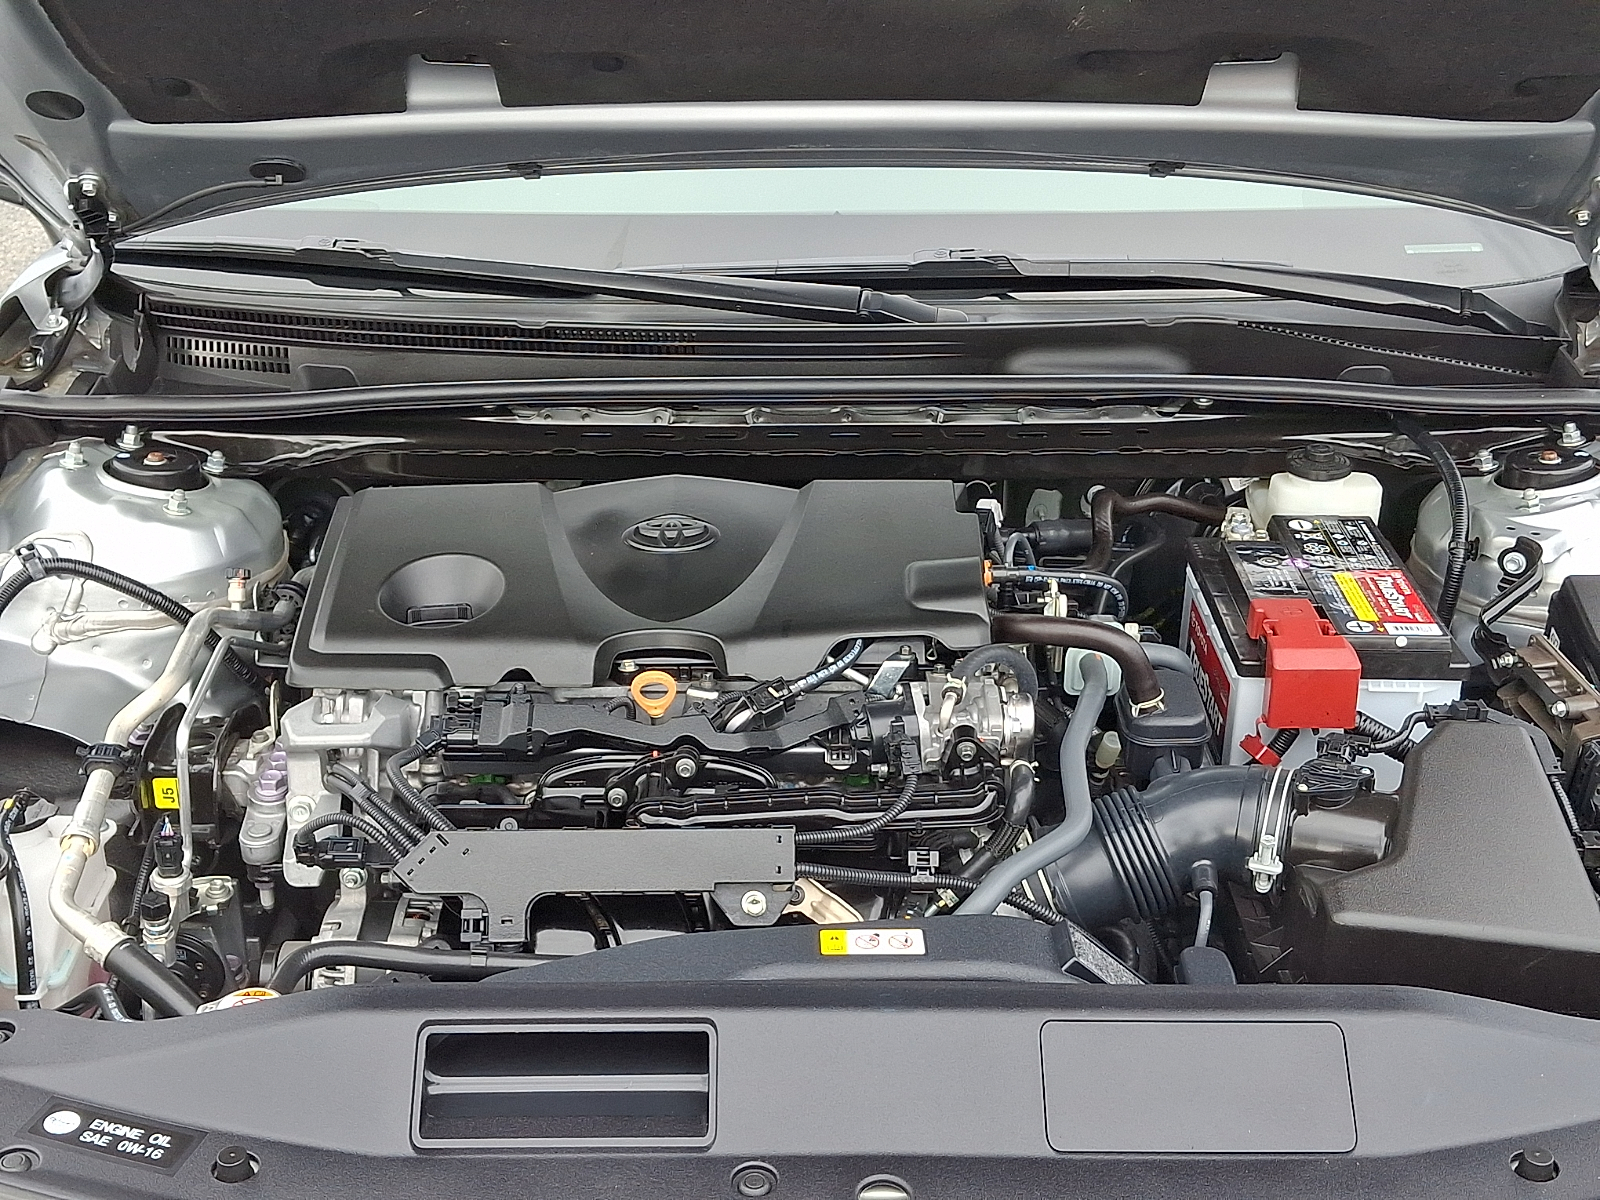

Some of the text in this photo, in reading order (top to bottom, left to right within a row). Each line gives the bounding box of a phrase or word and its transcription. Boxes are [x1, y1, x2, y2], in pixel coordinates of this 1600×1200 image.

[161, 787, 176, 803] J5
[78, 1130, 165, 1160] SAE 0W-16
[88, 1118, 146, 1141] ENGINE
[148, 1133, 172, 1148] OIL
